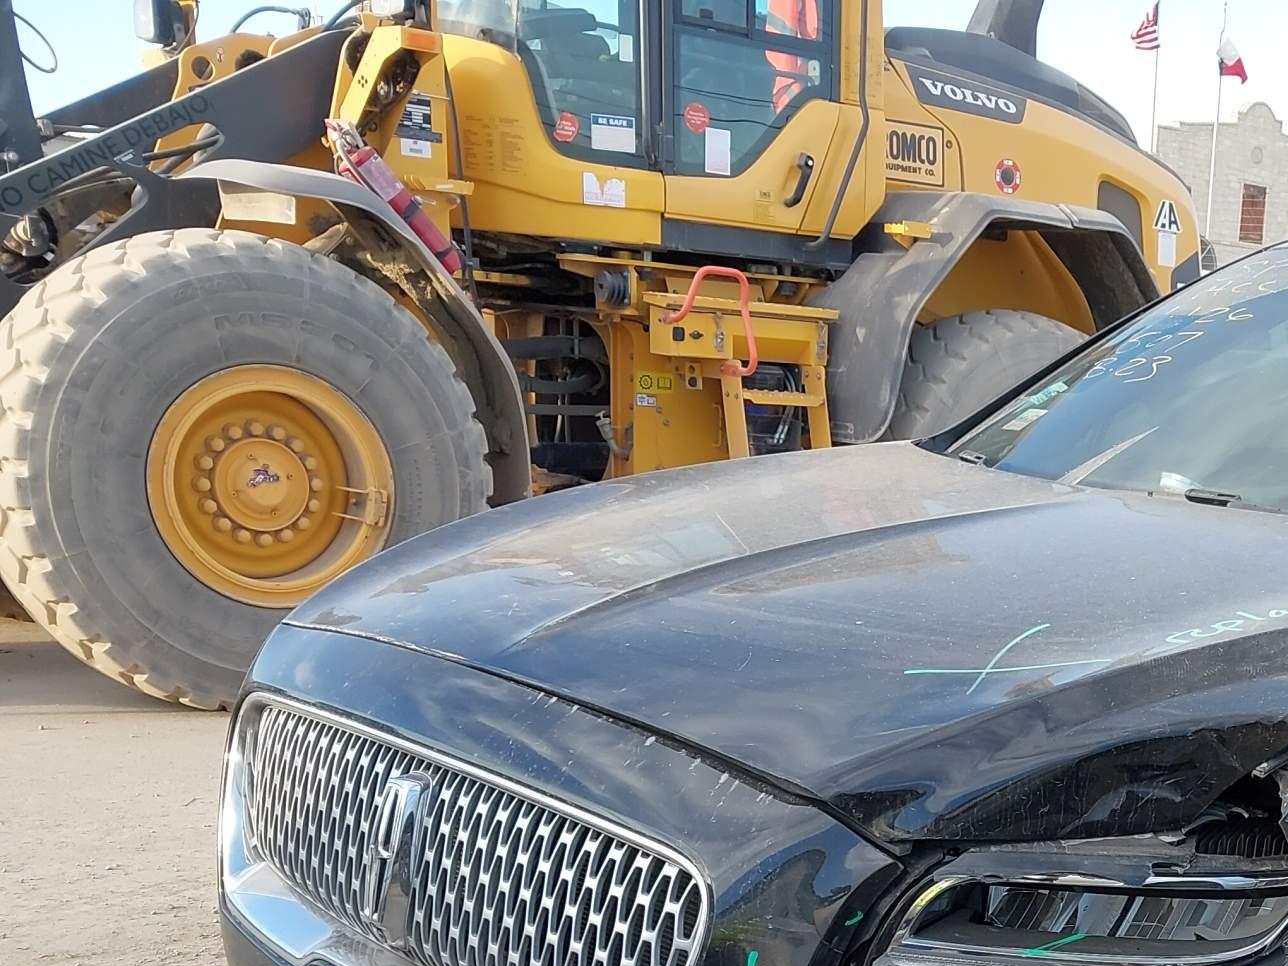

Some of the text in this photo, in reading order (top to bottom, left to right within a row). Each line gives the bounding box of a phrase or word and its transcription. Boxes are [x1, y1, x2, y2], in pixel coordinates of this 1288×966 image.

[919, 77, 1017, 114] VOLVO
[609, 118, 628, 127] SAFE
[886, 130, 937, 166] OMCO
[28, 138, 119, 195] CAMINE
